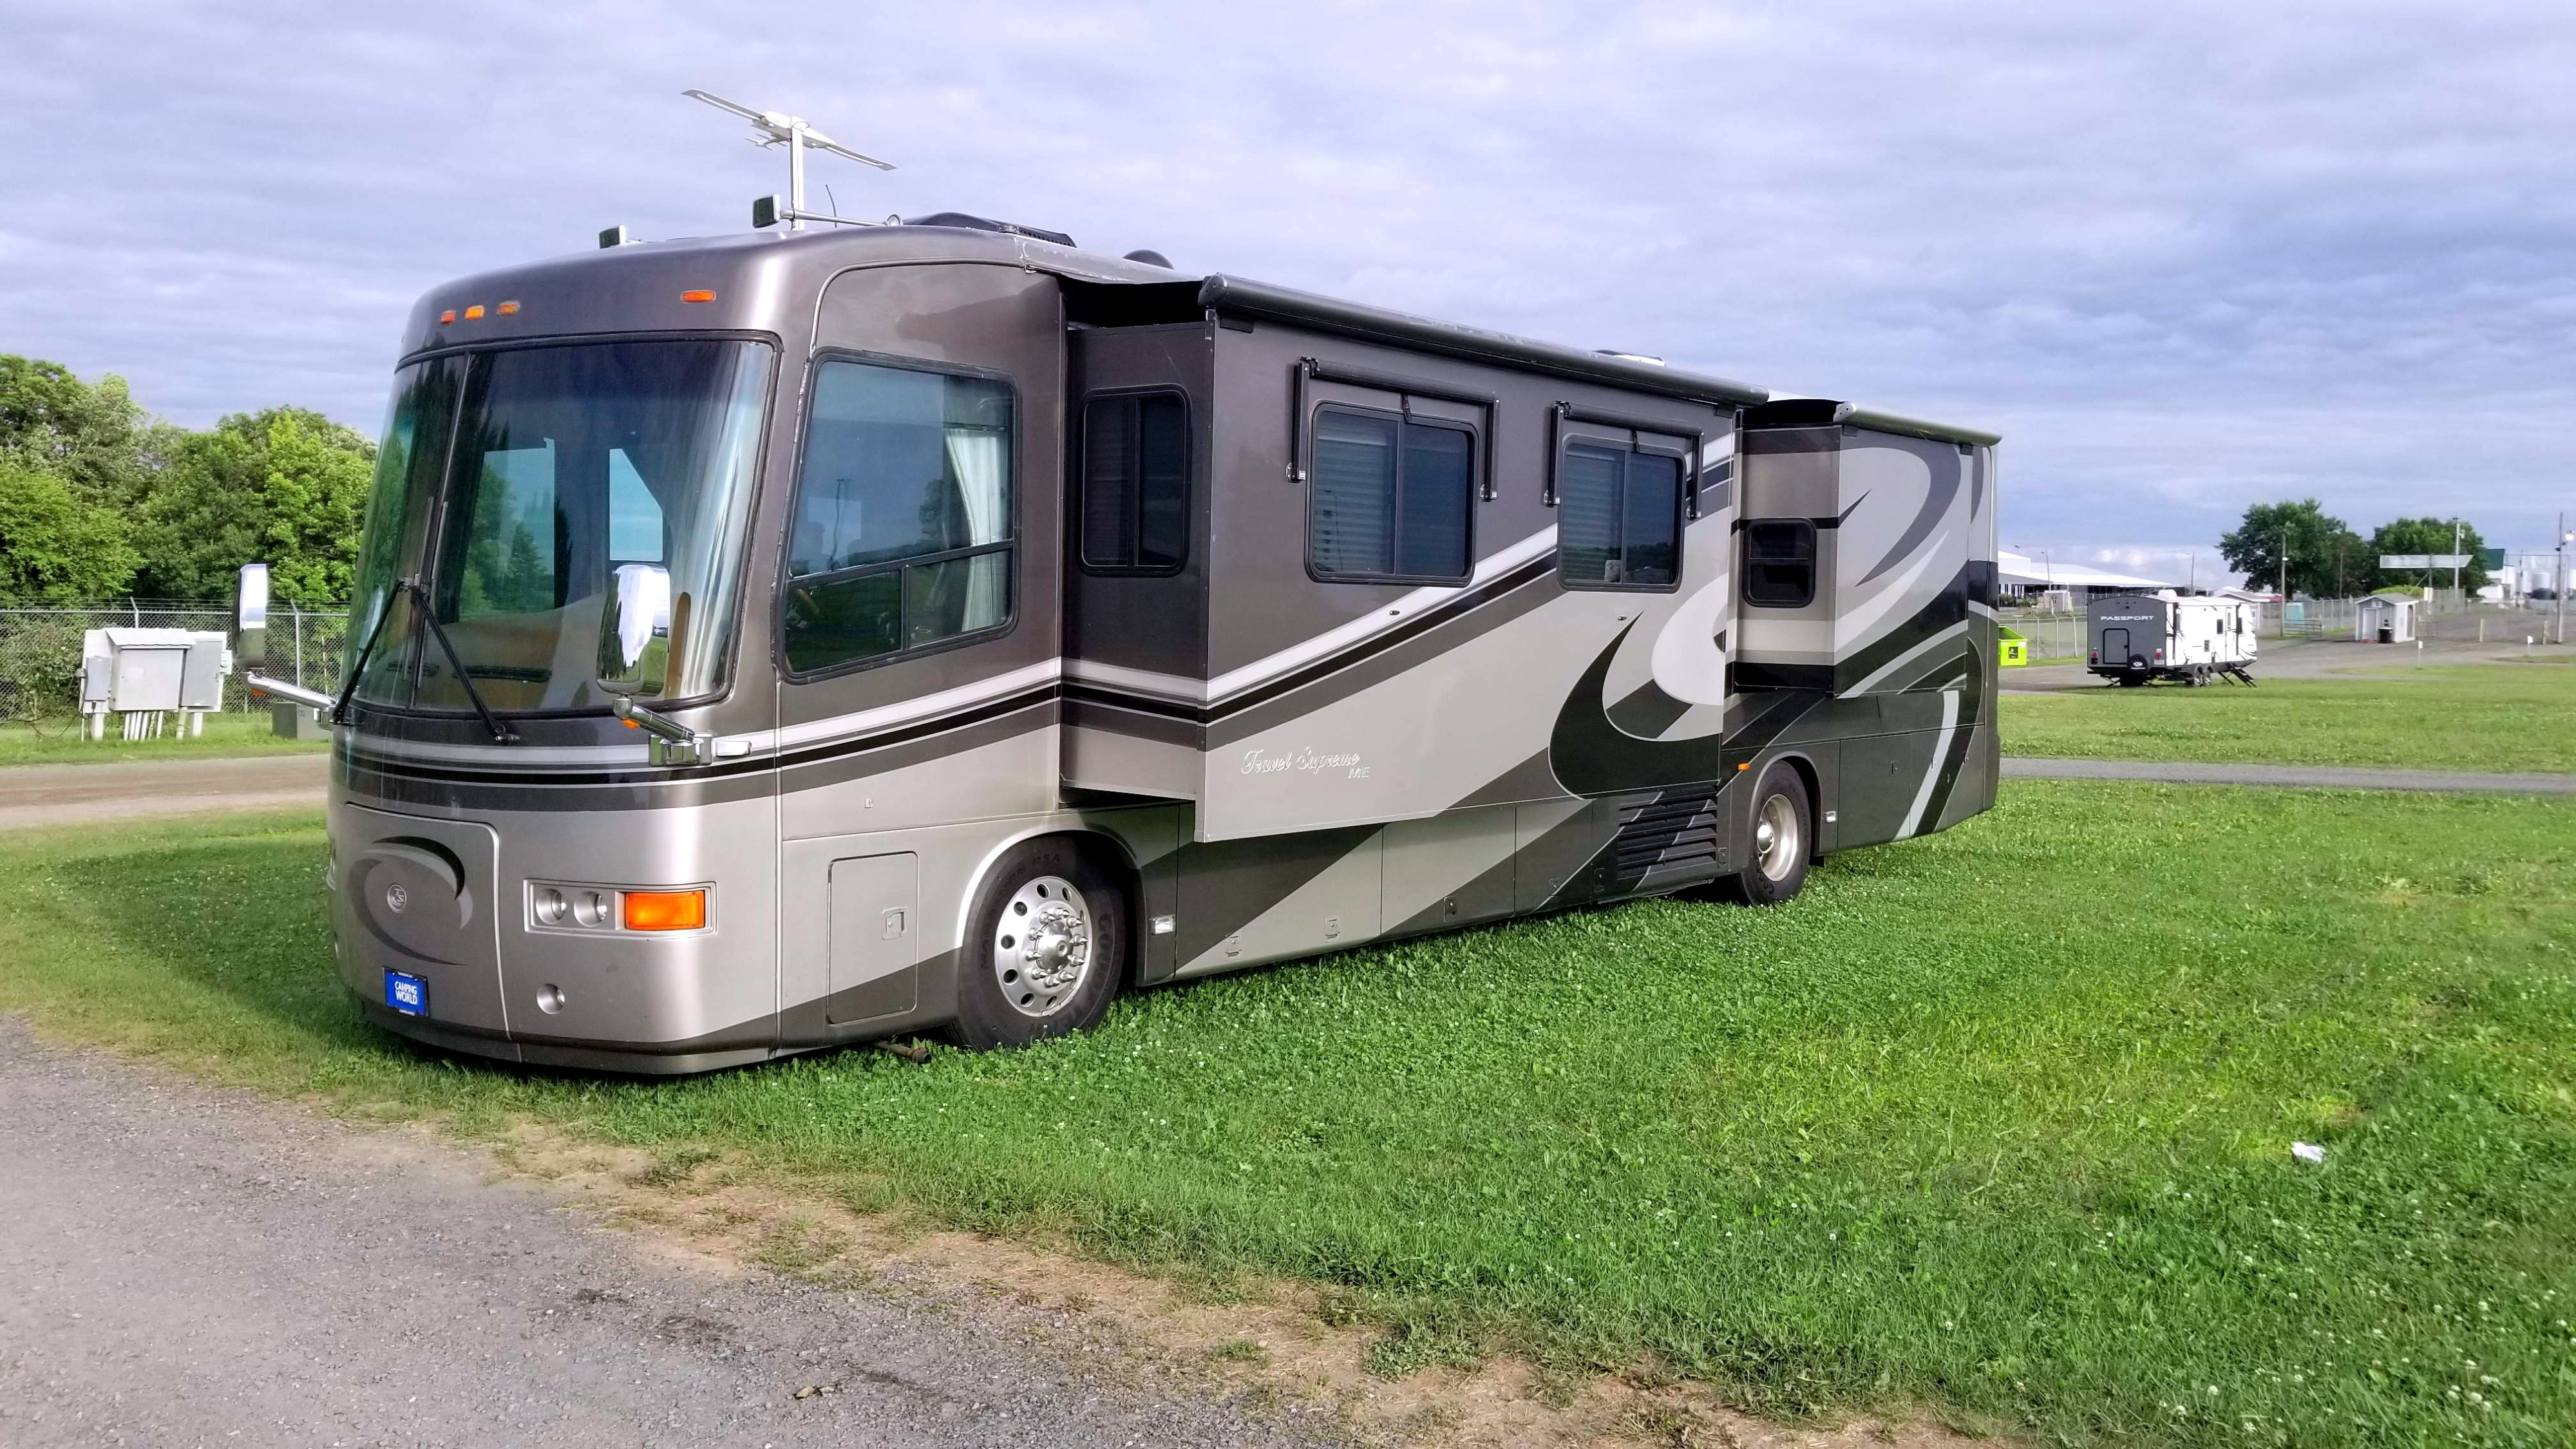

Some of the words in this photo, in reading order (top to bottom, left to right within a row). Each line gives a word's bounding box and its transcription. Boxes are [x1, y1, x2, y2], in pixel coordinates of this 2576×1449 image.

[1241, 749, 1293, 774] Travel
[1296, 746, 1361, 775] Supreme
[395, 981, 418, 995] CAMPING
[395, 990, 418, 1005] WORLD
